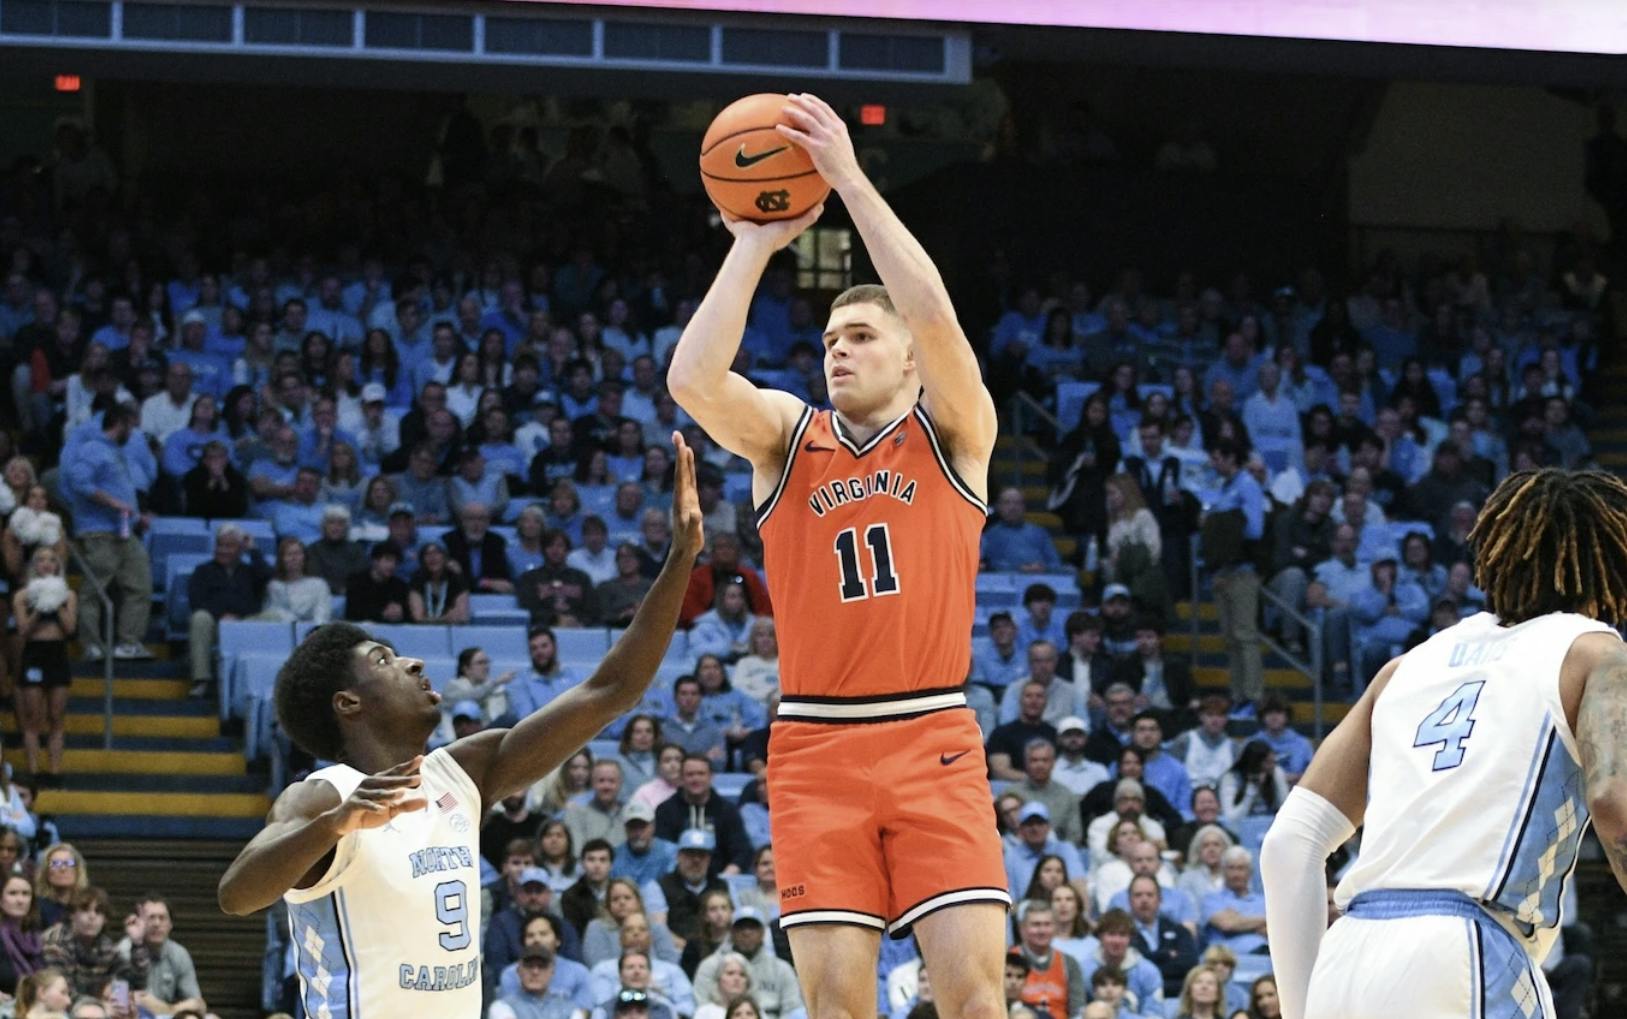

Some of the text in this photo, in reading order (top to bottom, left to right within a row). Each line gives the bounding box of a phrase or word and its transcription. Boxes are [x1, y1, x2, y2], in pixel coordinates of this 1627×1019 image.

[808, 469, 917, 518] VIRGINIA
[833, 522, 901, 604] 11
[1412, 679, 1487, 772] 4
[408, 845, 473, 879] NORTH
[433, 879, 472, 952] 9
